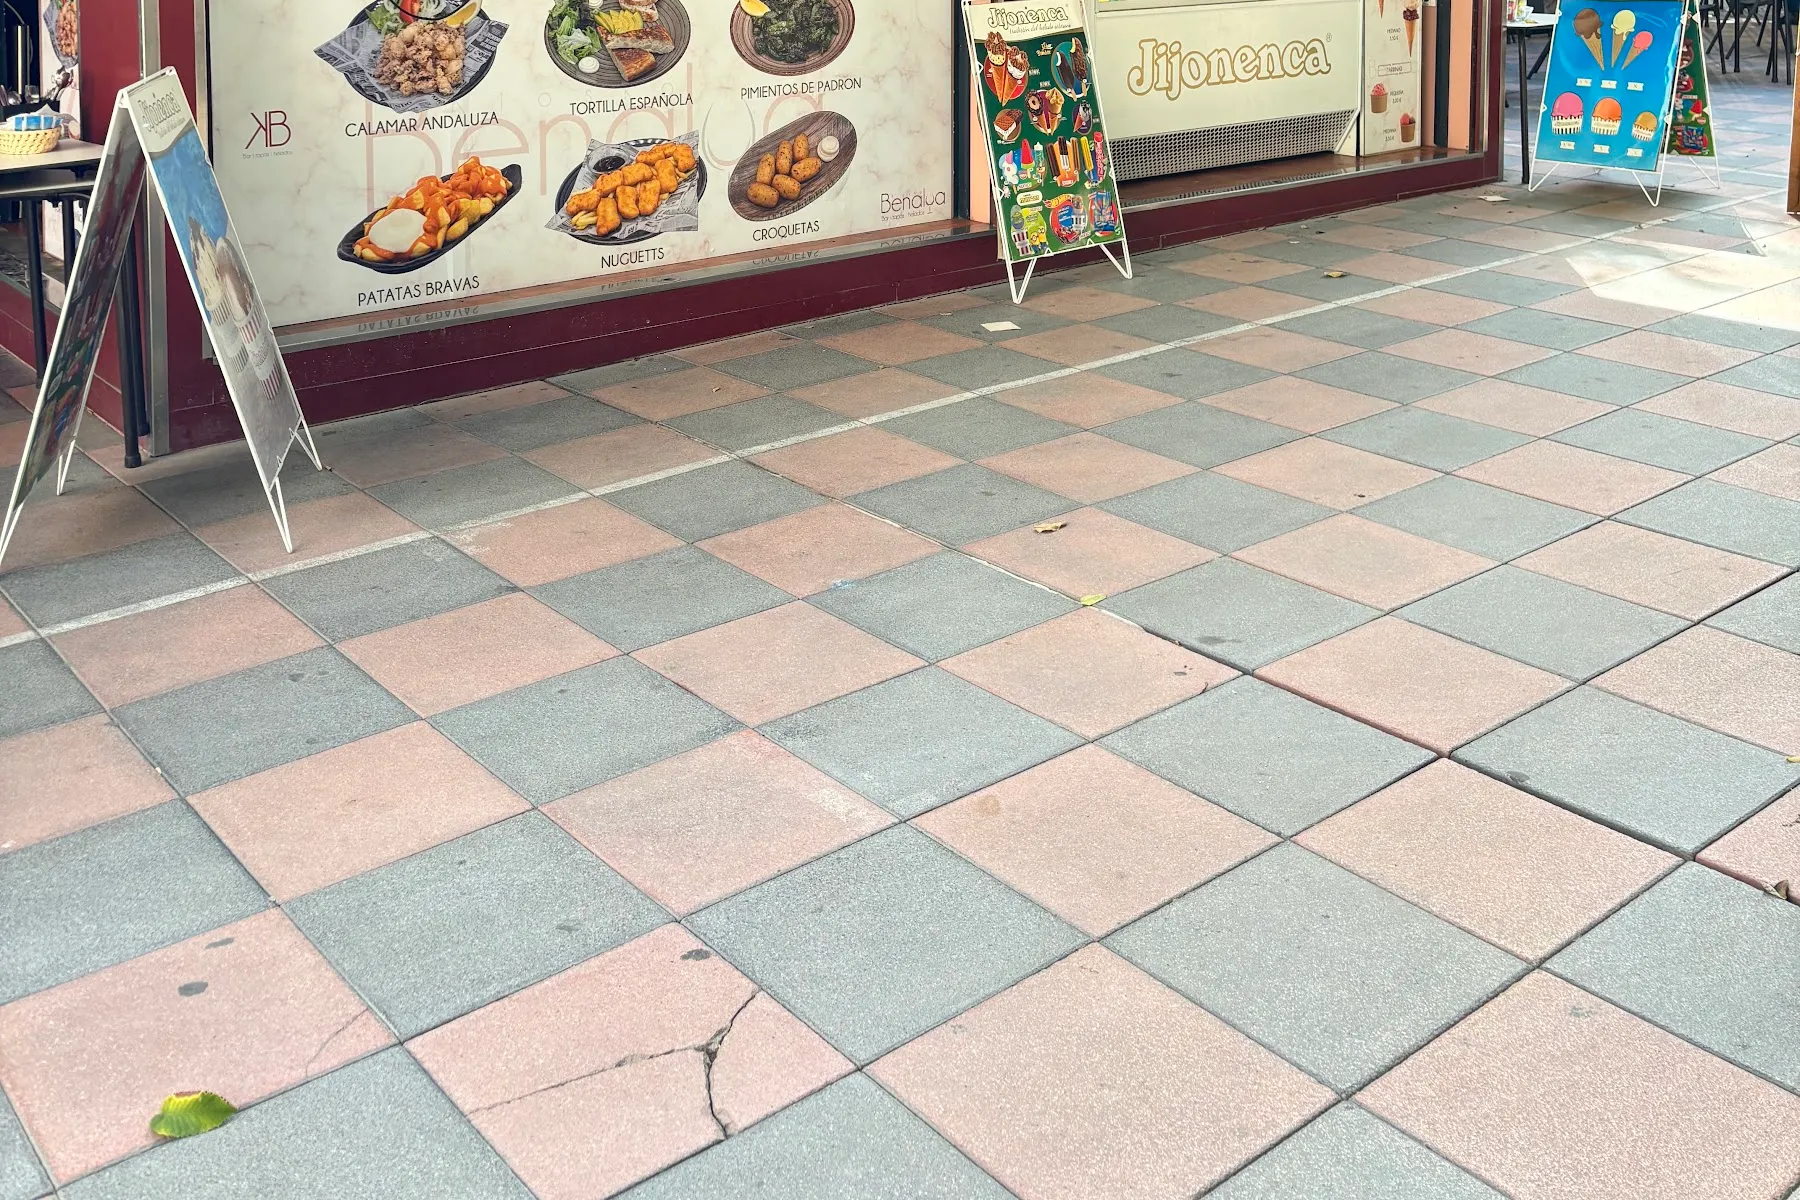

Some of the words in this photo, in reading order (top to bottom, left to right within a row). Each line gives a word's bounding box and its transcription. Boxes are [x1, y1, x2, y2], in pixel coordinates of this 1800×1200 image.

[987, 6, 1069, 31] Jijonenca
[1127, 38, 1332, 101] Jijonenca
[740, 83, 798, 100] PIMIENTOS
[801, 81, 815, 94] DE
[817, 77, 862, 93] PADRON
[569, 98, 627, 116] TORTILLA
[630, 92, 694, 110] ESPAÑOLA
[345, 118, 418, 137] CALAMAR
[421, 111, 499, 131] ANDALUZA
[752, 220, 820, 243] CROQUETAS
[600, 247, 665, 269] NUGUETTS
[357, 284, 422, 307] PATATAS
[425, 275, 480, 296] BRAVAS
